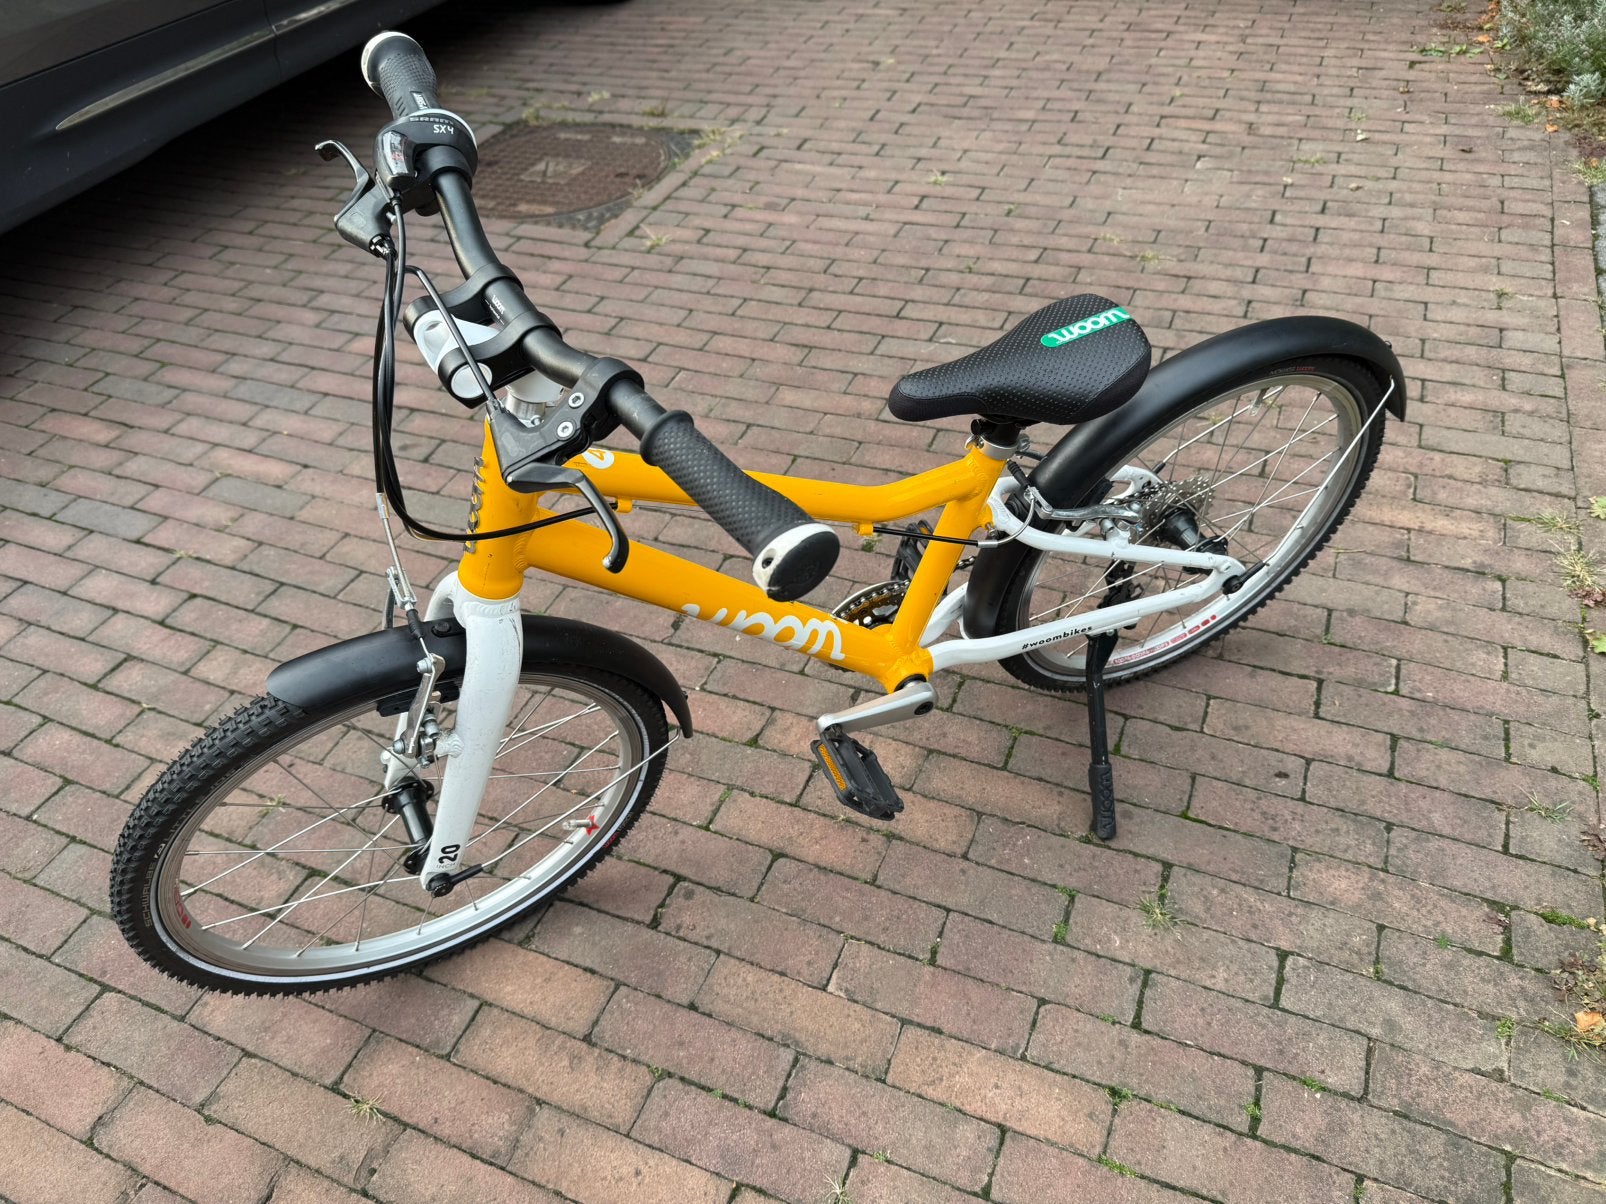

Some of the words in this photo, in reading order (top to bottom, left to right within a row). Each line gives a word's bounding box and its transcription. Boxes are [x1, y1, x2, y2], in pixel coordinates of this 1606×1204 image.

[433, 124, 454, 135] SX4
[1047, 308, 1130, 342] woom
[1021, 626, 1093, 650] #woombikes
[438, 844, 460, 864] 20
[142, 861, 157, 928] SCHWALBE
